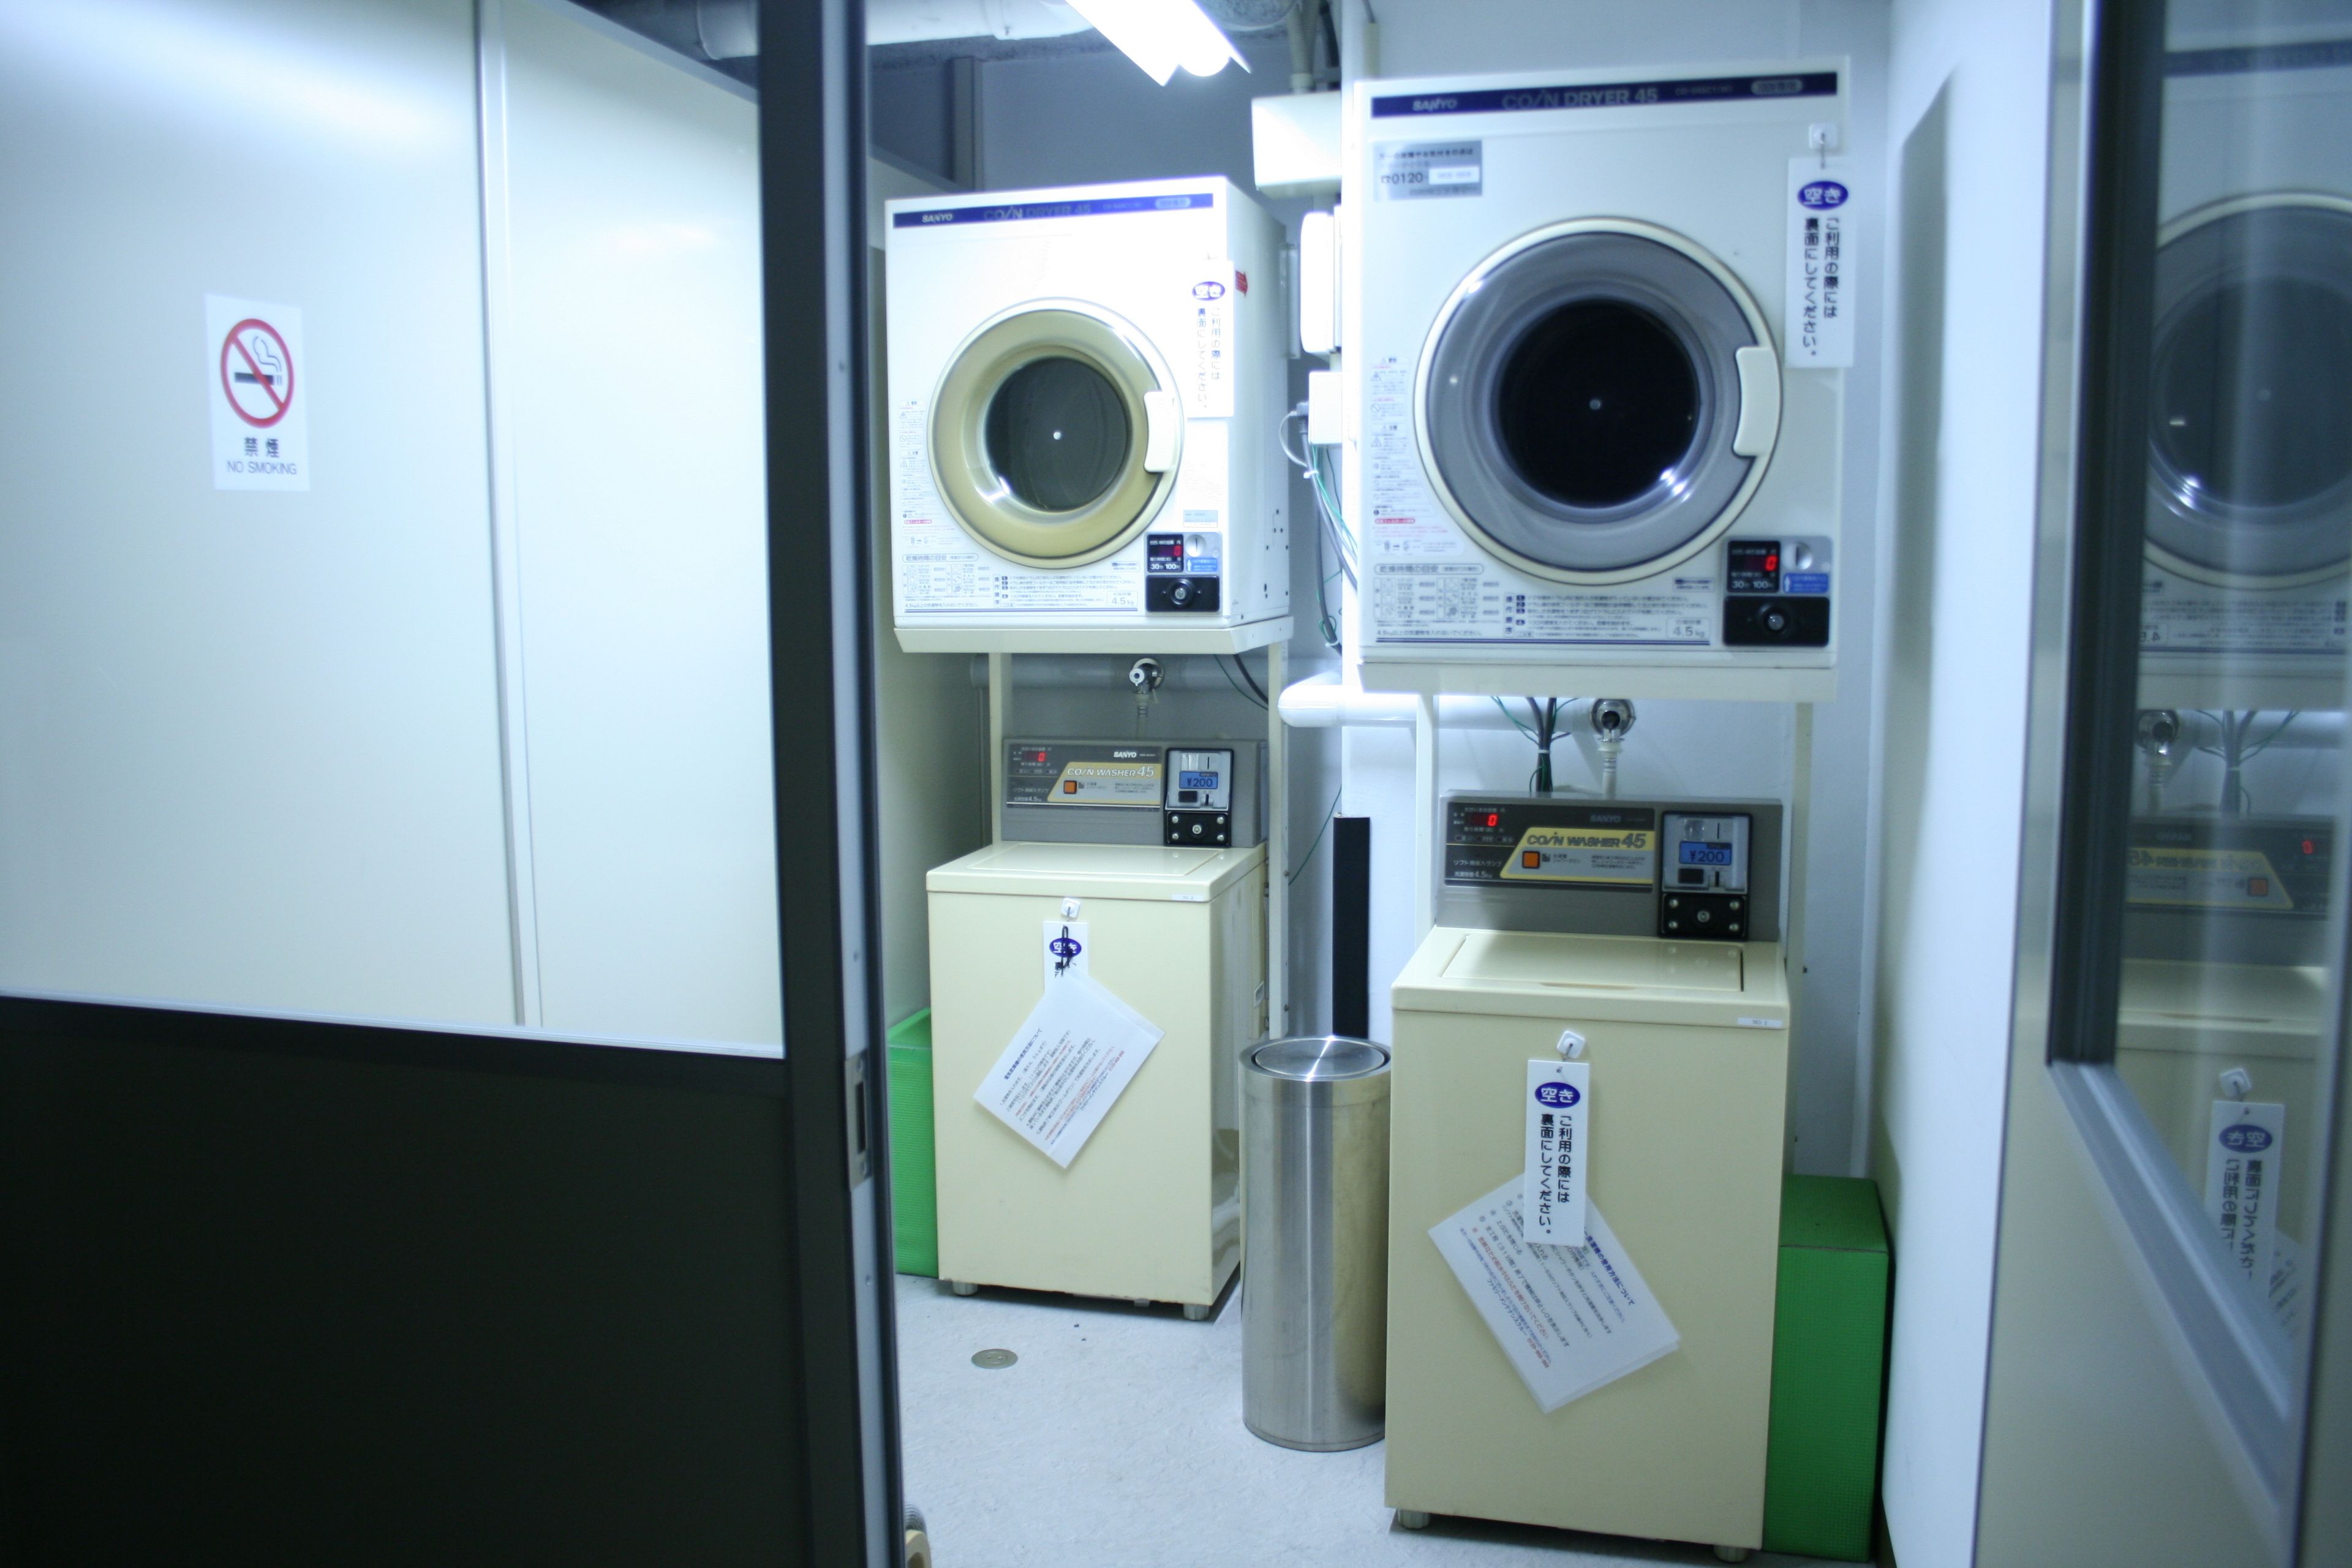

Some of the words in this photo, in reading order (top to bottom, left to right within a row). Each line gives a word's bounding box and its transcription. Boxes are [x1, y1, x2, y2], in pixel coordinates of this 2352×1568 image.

[1412, 99, 1457, 111] SANYO
[1564, 90, 1630, 107] DRYER
[1635, 88, 1658, 103] 45
[1804, 187, 1843, 205] 空き
[922, 213, 954, 222] SANYO
[1824, 217, 1841, 318] ご利用の際には
[1195, 284, 1221, 298] 空き
[1802, 217, 1819, 357] 裏面にしてください。
[1197, 308, 1207, 408] 裏面にしてください。
[244, 437, 279, 458] 禁煙
[227, 461, 244, 473] NO
[248, 461, 297, 475] SMOKING
[1765, 555, 1778, 571] 0
[1038, 752, 1046, 762] 0
[1068, 766, 1094, 775] COIN
[1137, 765, 1155, 777] 45
[1187, 778, 1213, 787] ¥200
[1487, 813, 1498, 826] 0
[1591, 815, 1621, 823] SANYO
[1527, 832, 1564, 846] COIN
[1567, 837, 1620, 848] WASHER
[1621, 833, 1646, 848] 45
[1690, 850, 1724, 862] ¥200
[1540, 1087, 1574, 1103] 空き
[1558, 1115, 1572, 1203] ご利用の際には
[1539, 1114, 1554, 1234] 裏面にしてください。
[1580, 1226, 1635, 1307] ー洗濯機の使用方法について
